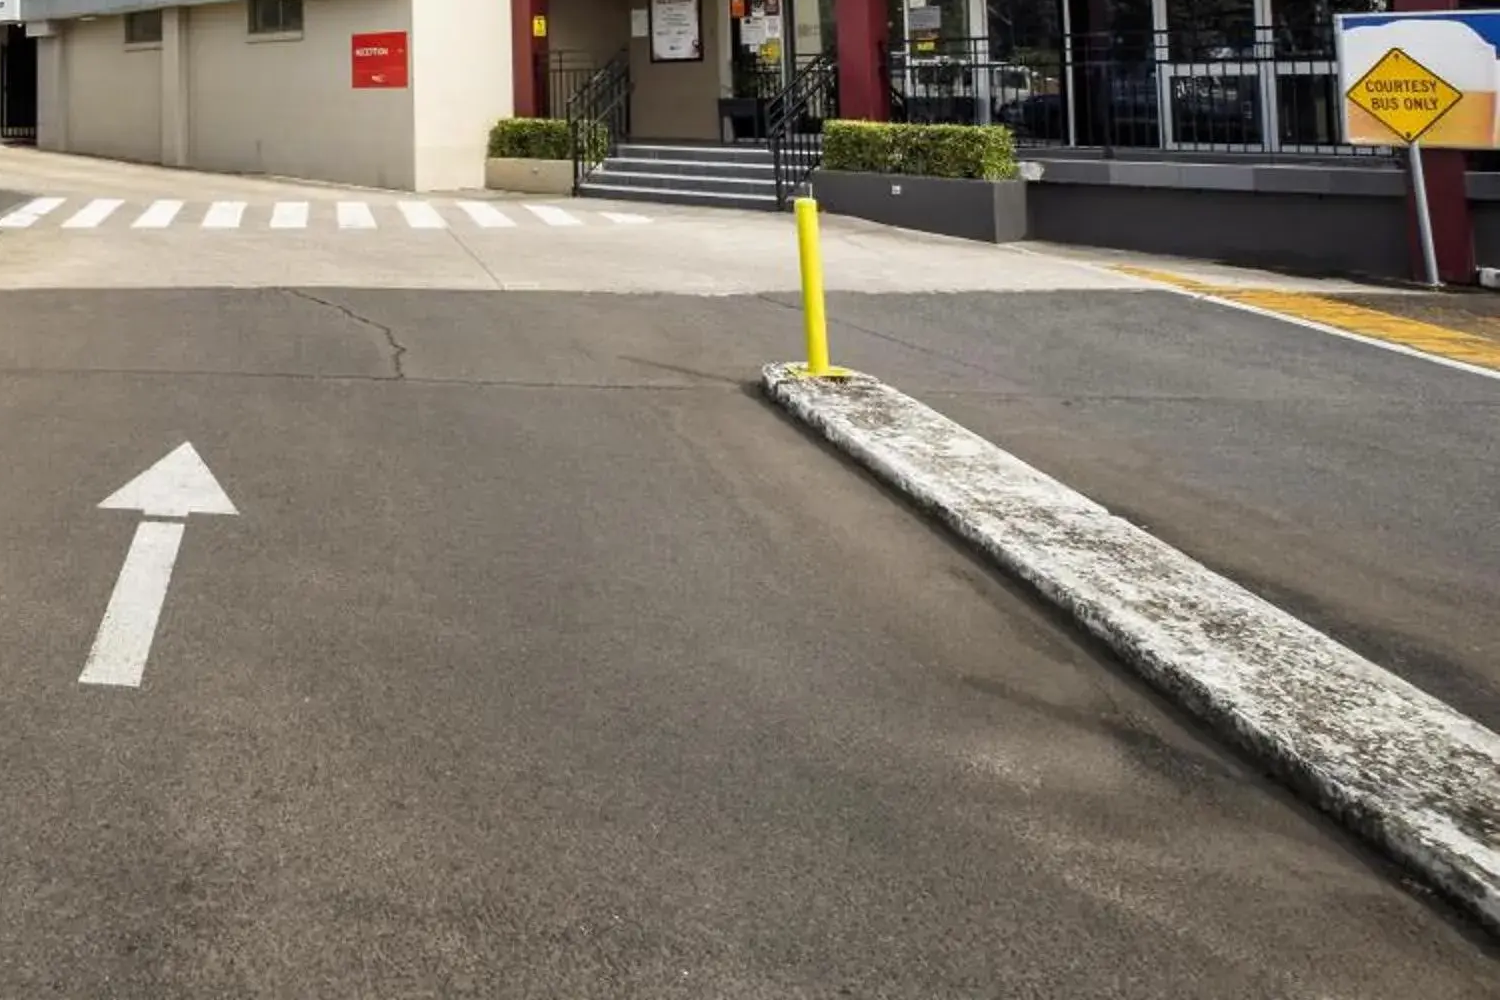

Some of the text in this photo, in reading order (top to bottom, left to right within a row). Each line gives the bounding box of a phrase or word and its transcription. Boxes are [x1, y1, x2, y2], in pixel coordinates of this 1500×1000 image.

[1364, 79, 1437, 93] COURTESY
[1370, 96, 1438, 111] BUS ONLY
